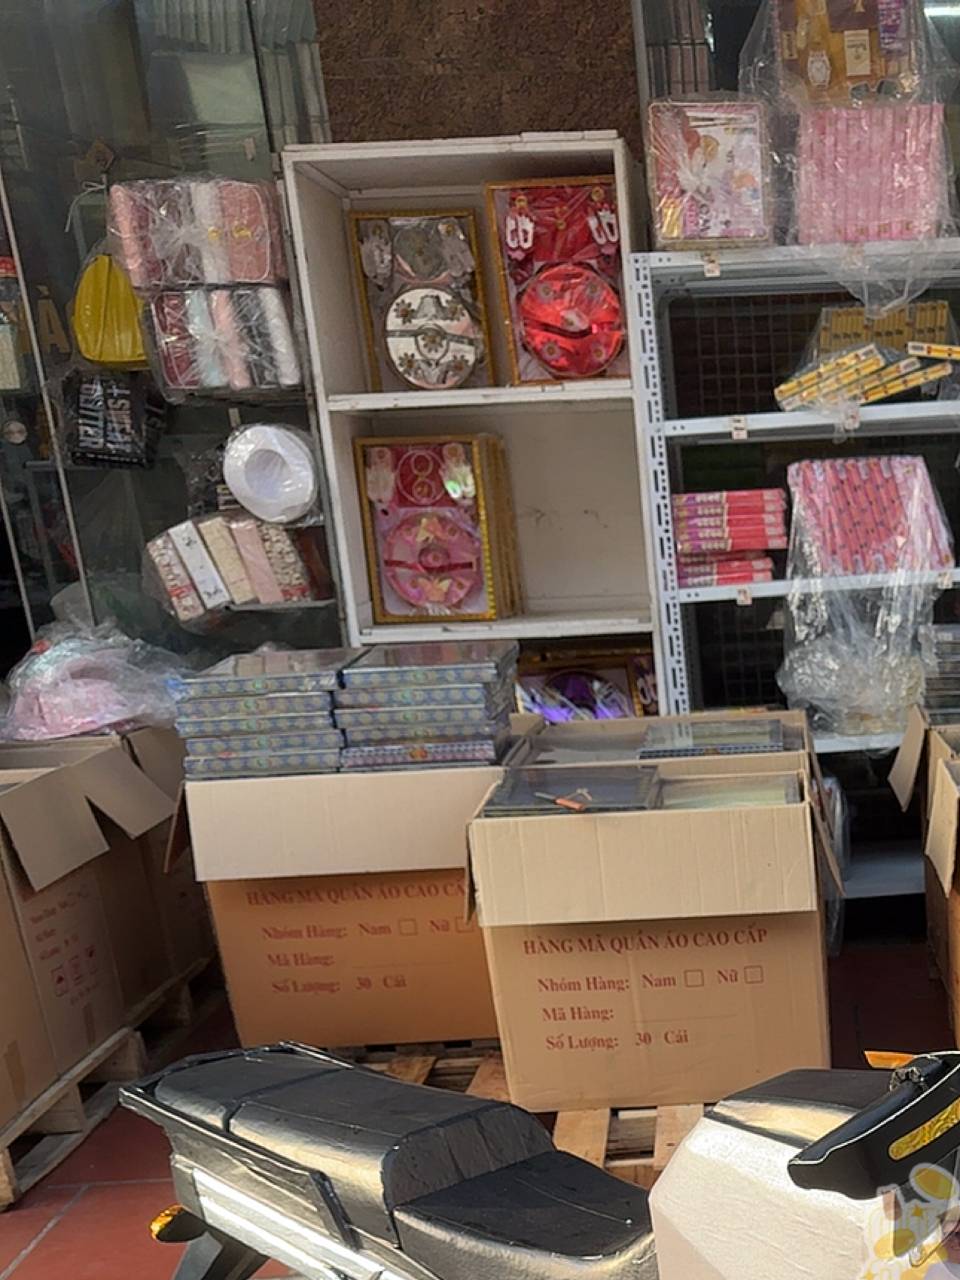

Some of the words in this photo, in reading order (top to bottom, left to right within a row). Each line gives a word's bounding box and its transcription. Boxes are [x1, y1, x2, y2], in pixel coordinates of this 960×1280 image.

[523, 934, 574, 955] HÀNG
[693, 930, 729, 947] CAO
[538, 976, 582, 993] Nhóm
[585, 975, 631, 993] Hàng:
[641, 973, 677, 989] Nam
[717, 968, 739, 984] Nữ
[542, 1006, 567, 1022] Mã
[571, 1005, 614, 1023] Hàng:
[546, 1032, 565, 1050] Số
[635, 1031, 652, 1047] 30
[663, 1029, 689, 1046] Cái
